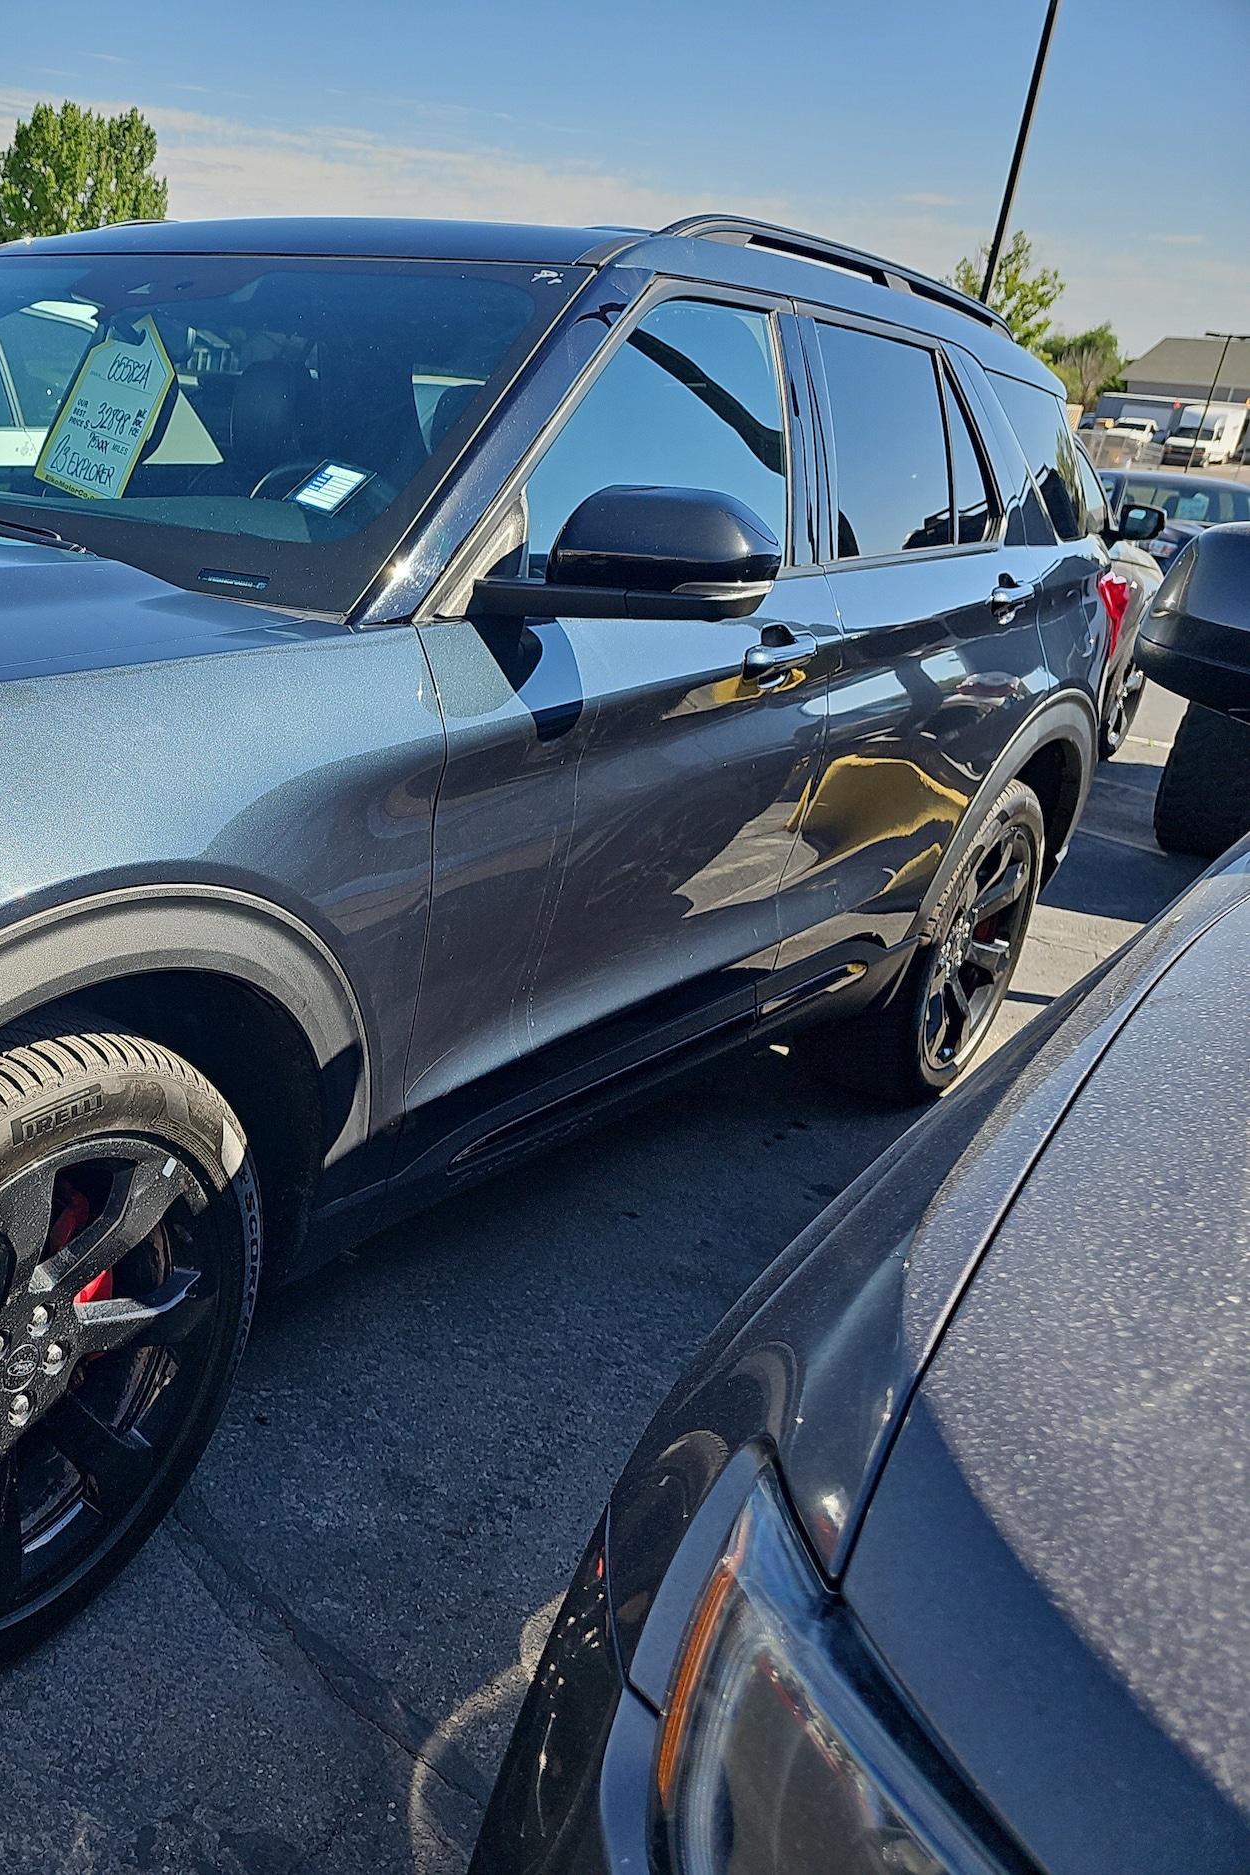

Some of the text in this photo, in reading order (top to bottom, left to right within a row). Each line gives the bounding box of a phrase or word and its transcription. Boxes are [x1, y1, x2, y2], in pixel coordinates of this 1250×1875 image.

[77, 397, 89, 408] OUR
[72, 407, 88, 418] BEST
[111, 442, 129, 456] MILES
[66, 451, 115, 489] EXPLORER
[10, 1083, 105, 1148] PIRELLI
